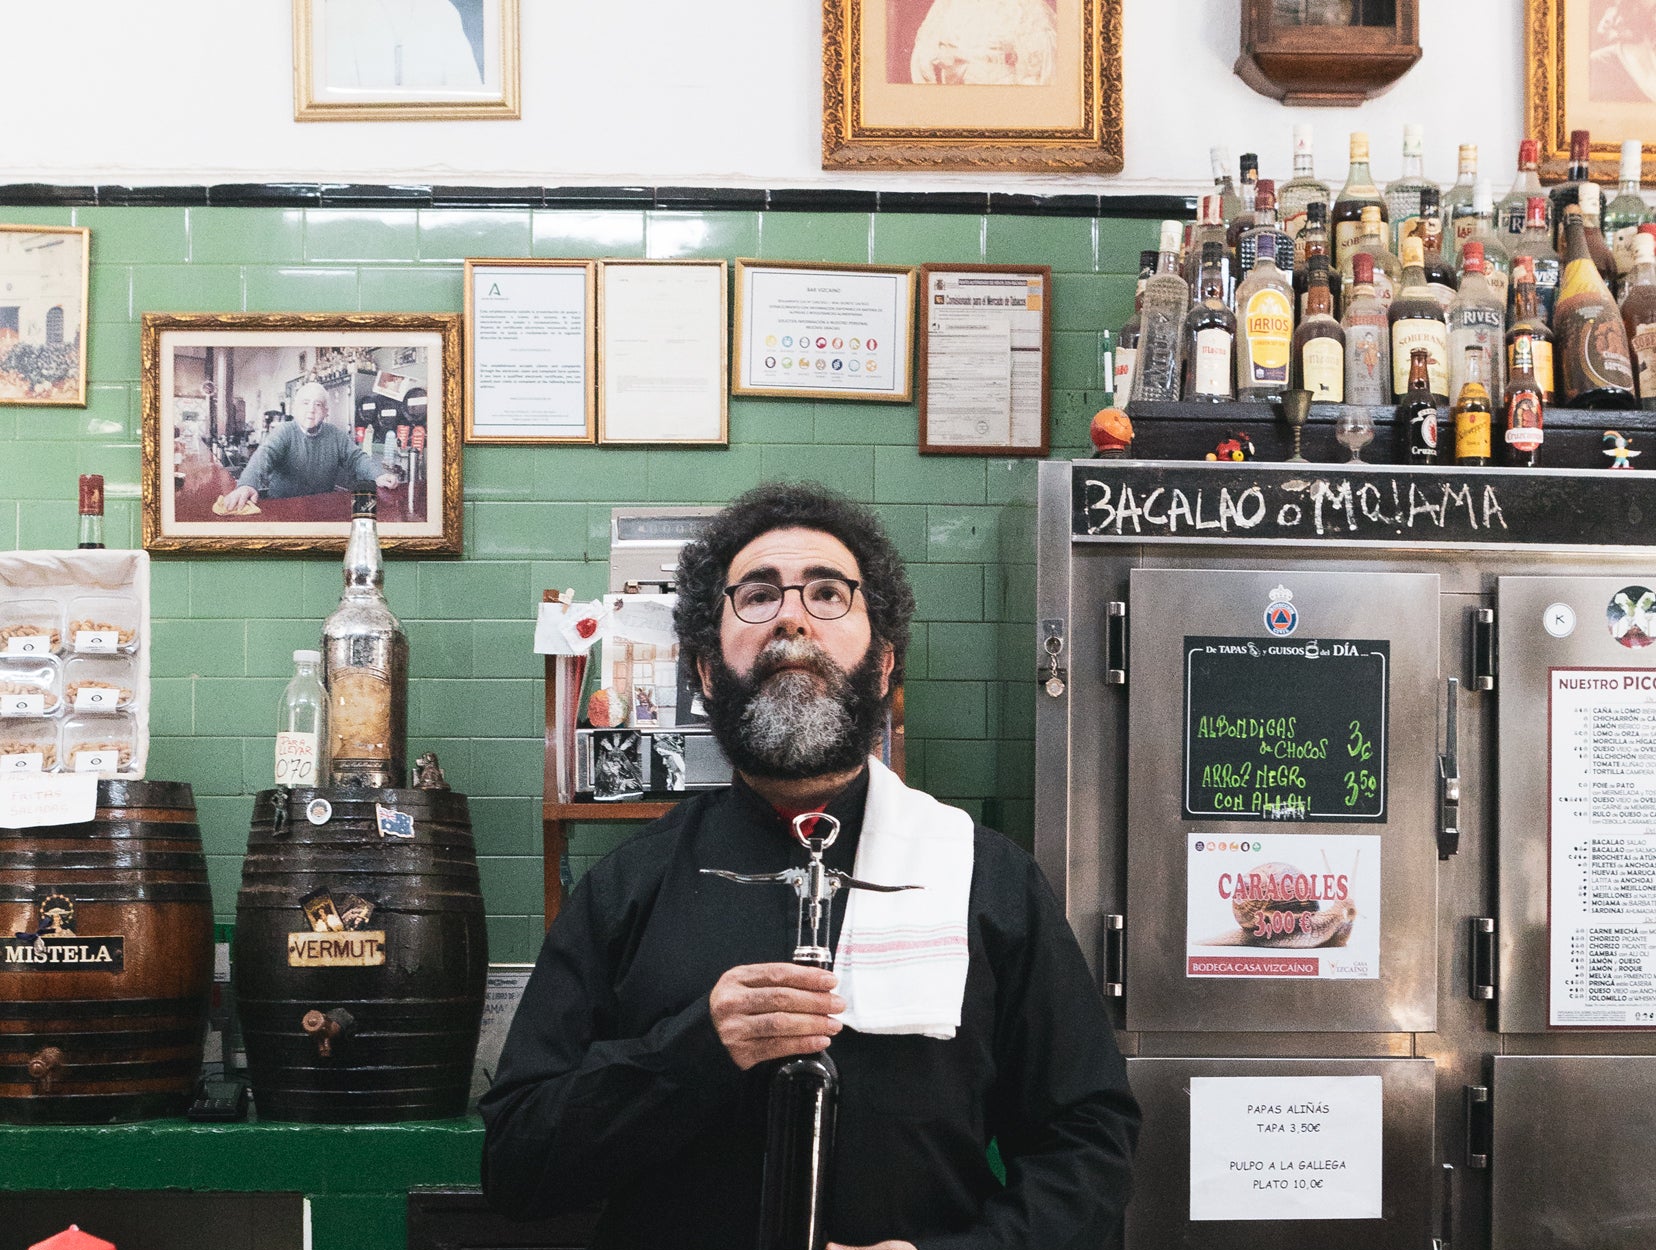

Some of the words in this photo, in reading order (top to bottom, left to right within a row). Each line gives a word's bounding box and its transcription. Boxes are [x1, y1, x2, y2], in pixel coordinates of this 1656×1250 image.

[1249, 316, 1289, 333] LARIOS
[1463, 310, 1500, 325] RIVES
[1085, 480, 1266, 535] BACALAO
[1554, 614, 1565, 625] K
[1218, 645, 1247, 654] TAPAS
[1268, 646, 1304, 656] GUISOS
[1320, 648, 1330, 656] del
[1559, 679, 1619, 690] NUESTRO
[1274, 739, 1329, 759] CHOCOS
[1256, 765, 1306, 789] NEGRO
[1214, 792, 1243, 810] CON
[1218, 872, 1348, 902] CARACOLES
[1253, 910, 1295, 940] 3,00
[5, 945, 112, 964] MISTELA
[294, 940, 379, 960] VERMUT
[1192, 962, 1233, 973] BODEGA
[1234, 962, 1260, 973] CASA
[1261, 960, 1313, 973] VIZCAÍNO
[1247, 1104, 1282, 1114] PAPAS
[1286, 1102, 1330, 1114] ALIÑÁS
[1257, 1123, 1285, 1133] TAPA
[1290, 1123, 1321, 1134] 3,50€
[1230, 1161, 1264, 1171] PULPO
[1268, 1161, 1276, 1170] A
[1280, 1161, 1294, 1170] LA
[1299, 1160, 1346, 1170] GALLEGA
[1253, 1180, 1289, 1190] PLATO
[1294, 1180, 1323, 1190] 10,0€
